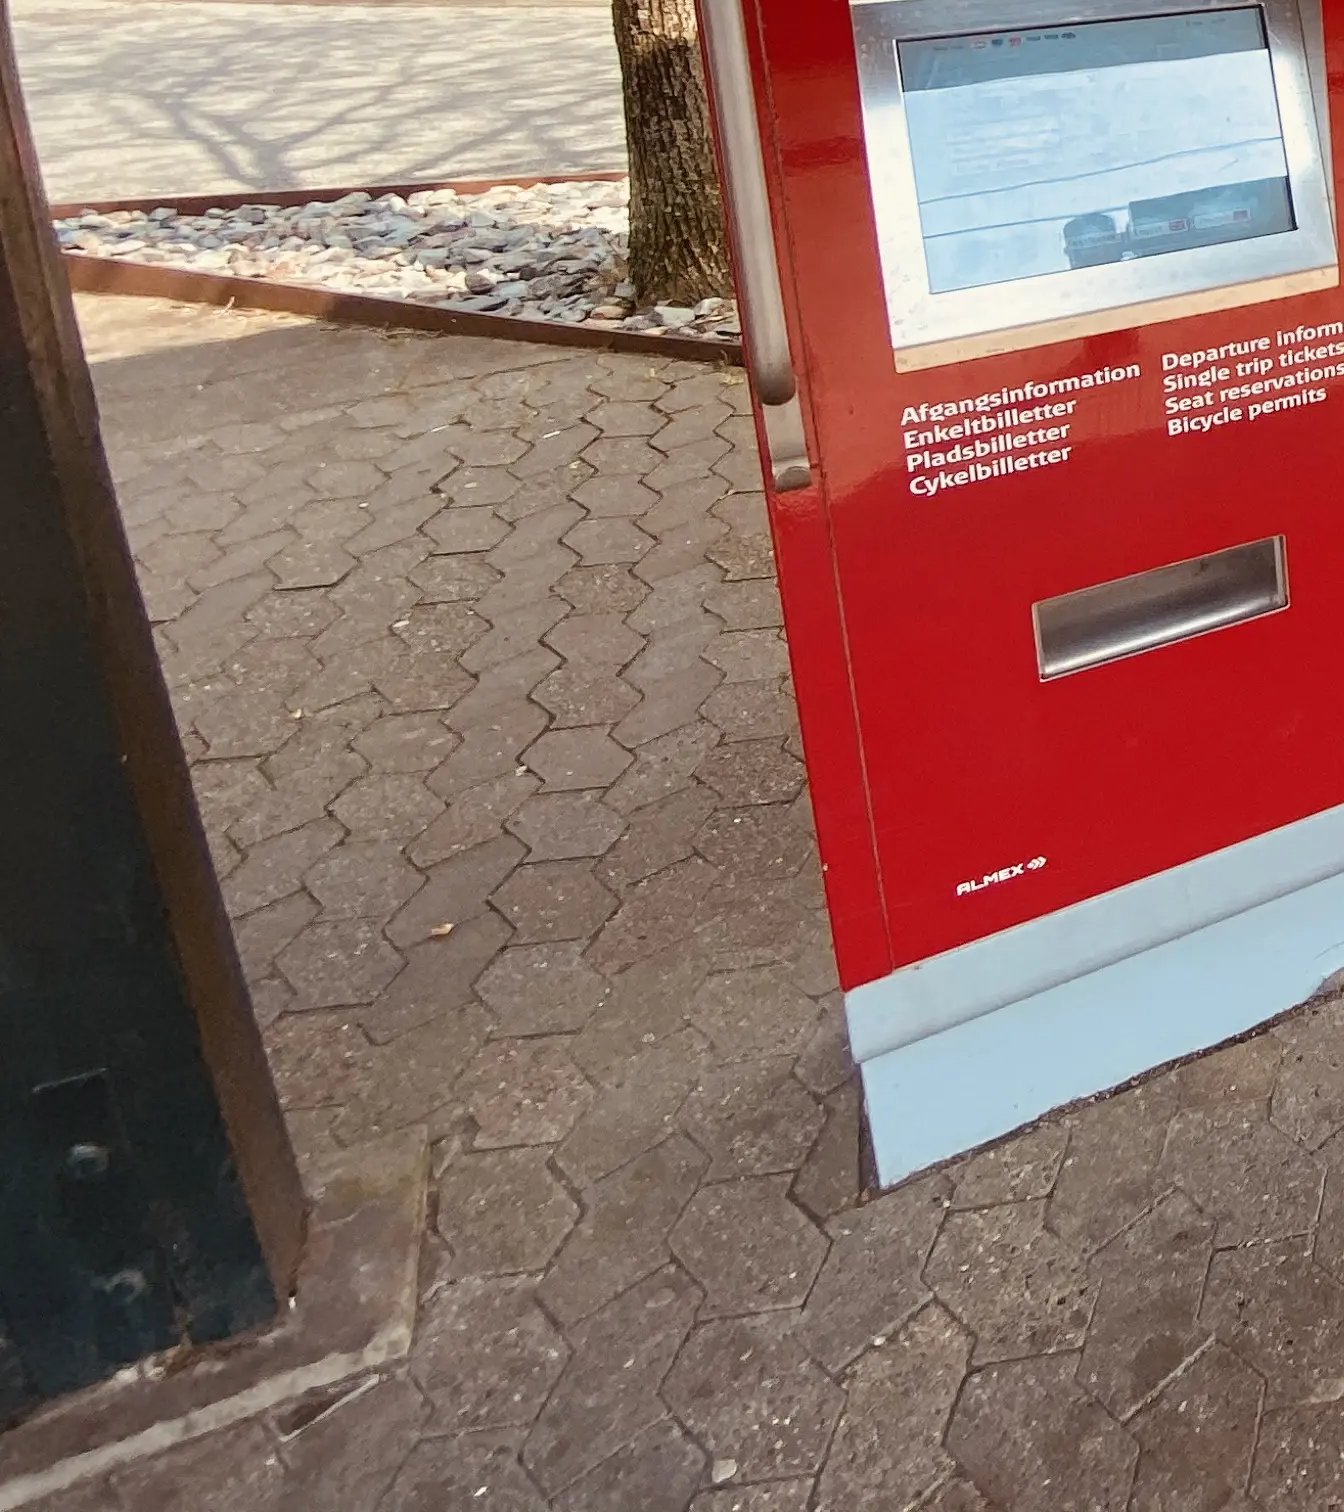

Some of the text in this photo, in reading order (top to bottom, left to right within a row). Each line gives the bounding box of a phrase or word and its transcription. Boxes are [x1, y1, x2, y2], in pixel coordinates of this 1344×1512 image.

[1161, 336, 1271, 371] Departure
[1163, 366, 1230, 393] Single
[1235, 356, 1273, 376] trip
[900, 364, 1142, 426] Afgangsinformation
[1165, 391, 1214, 414] Seat
[1168, 387, 1327, 436] Bicycle permits
[903, 399, 1077, 449] Enkeltbilletter
[906, 423, 1071, 472] Pladsbilletter
[909, 445, 1072, 497] Cykelbilletter
[956, 863, 1024, 896] ALMEX
